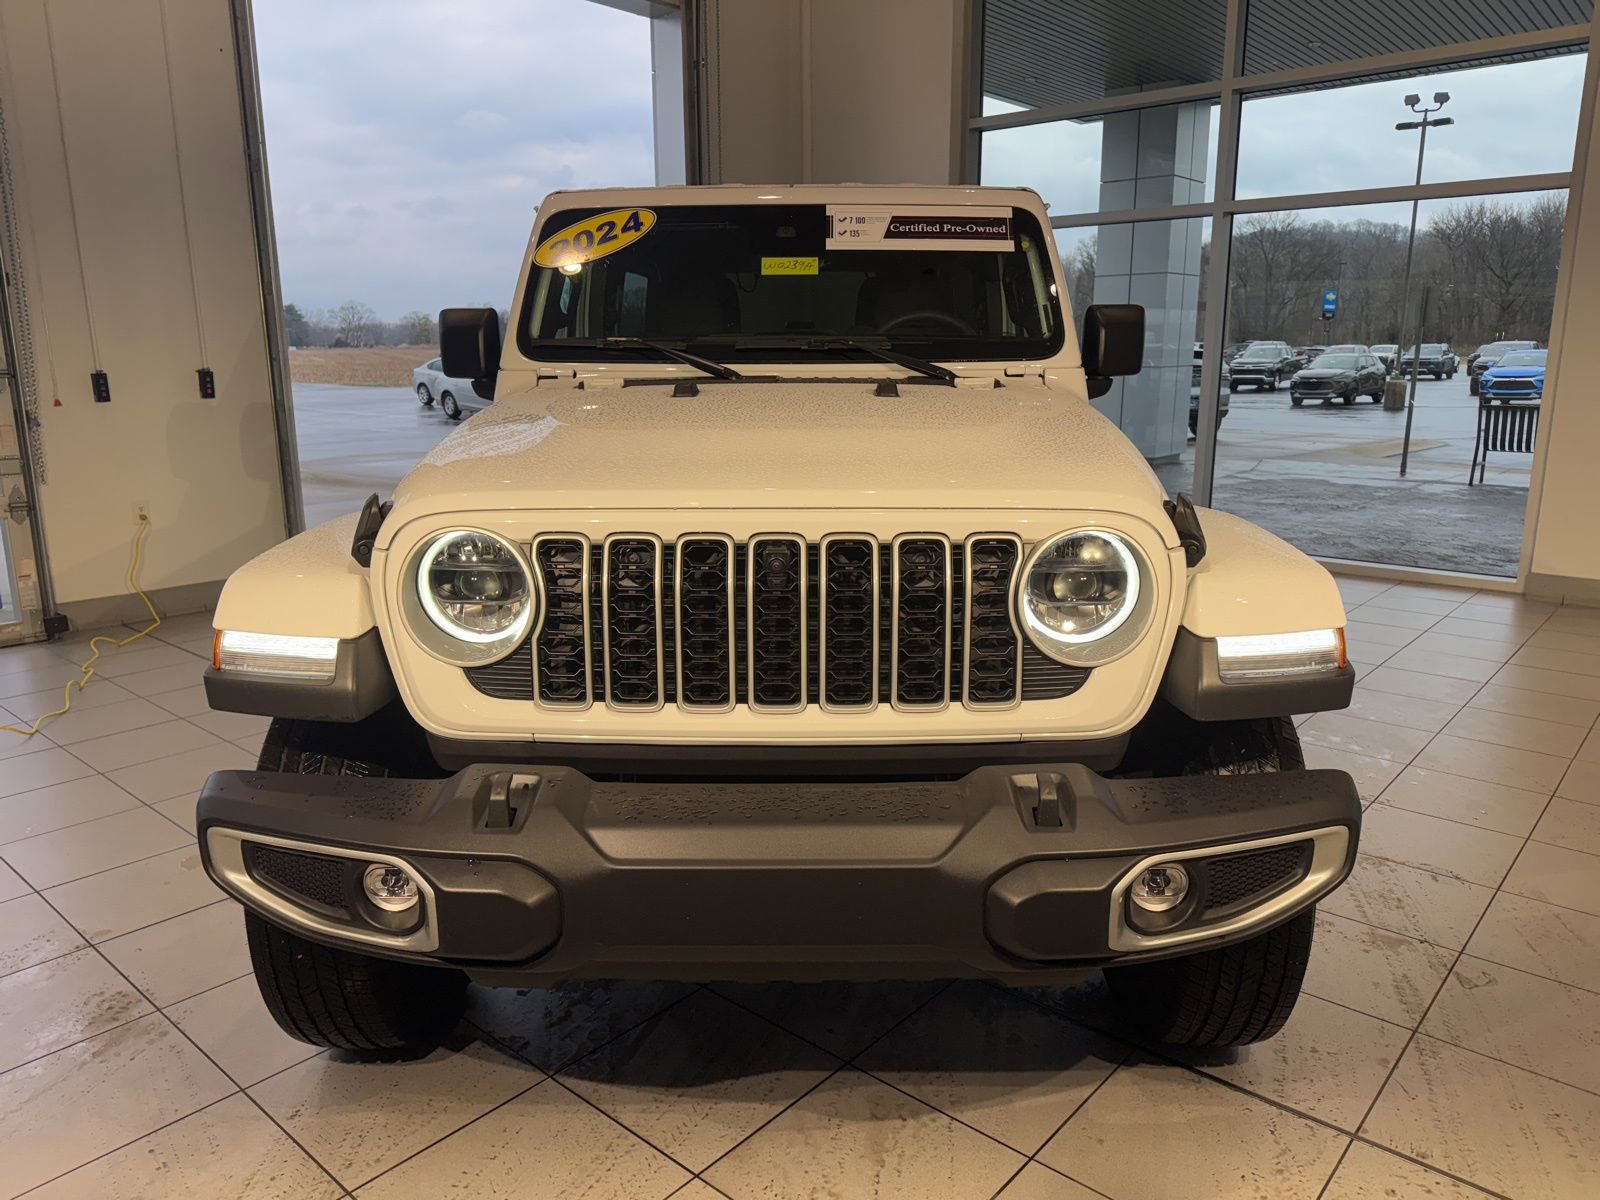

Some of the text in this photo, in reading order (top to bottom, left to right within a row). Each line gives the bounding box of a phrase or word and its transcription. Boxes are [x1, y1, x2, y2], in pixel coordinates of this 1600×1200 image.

[855, 216, 866, 225] 100
[890, 223, 1006, 233] Certified Pre-Owned
[548, 210, 645, 263] 2024
[849, 230, 860, 238] 135
